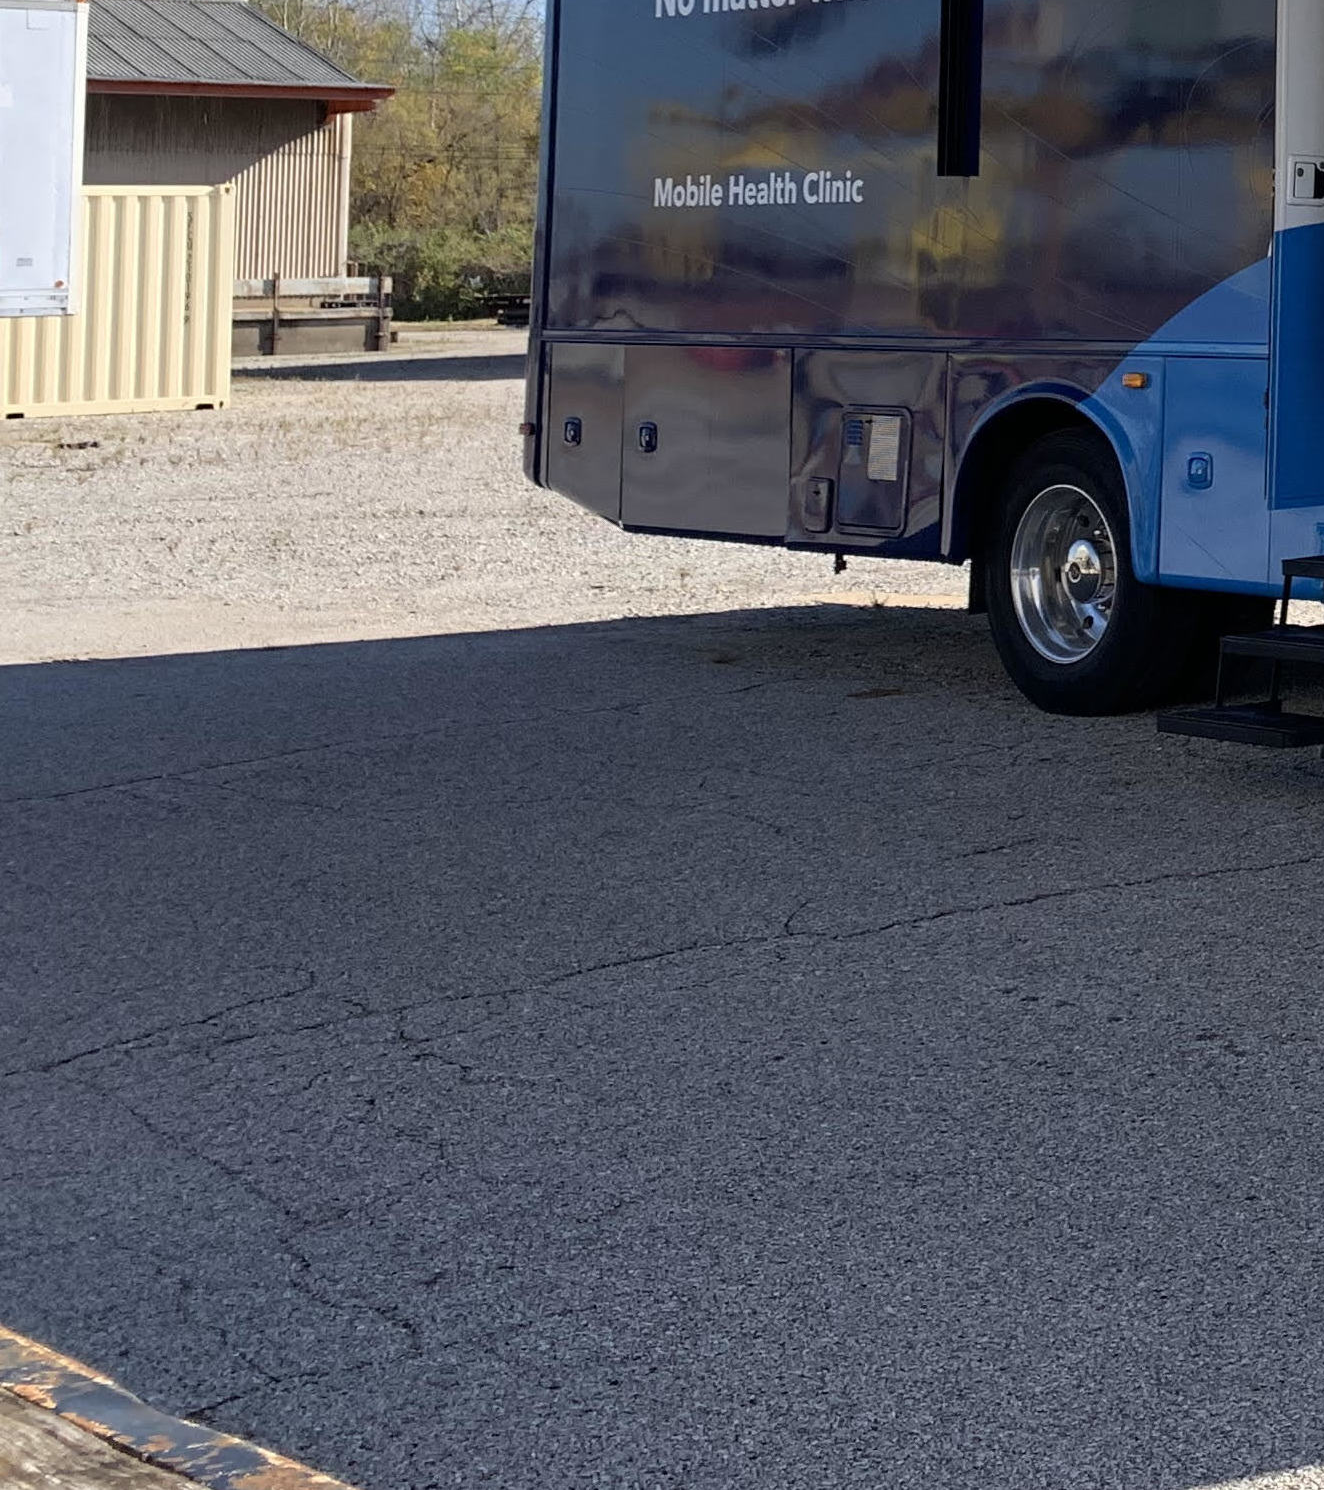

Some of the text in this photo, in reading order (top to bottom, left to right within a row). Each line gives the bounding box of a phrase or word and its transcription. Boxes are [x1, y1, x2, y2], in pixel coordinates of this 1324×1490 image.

[653, 170, 864, 207] Mobile Health Clinic
